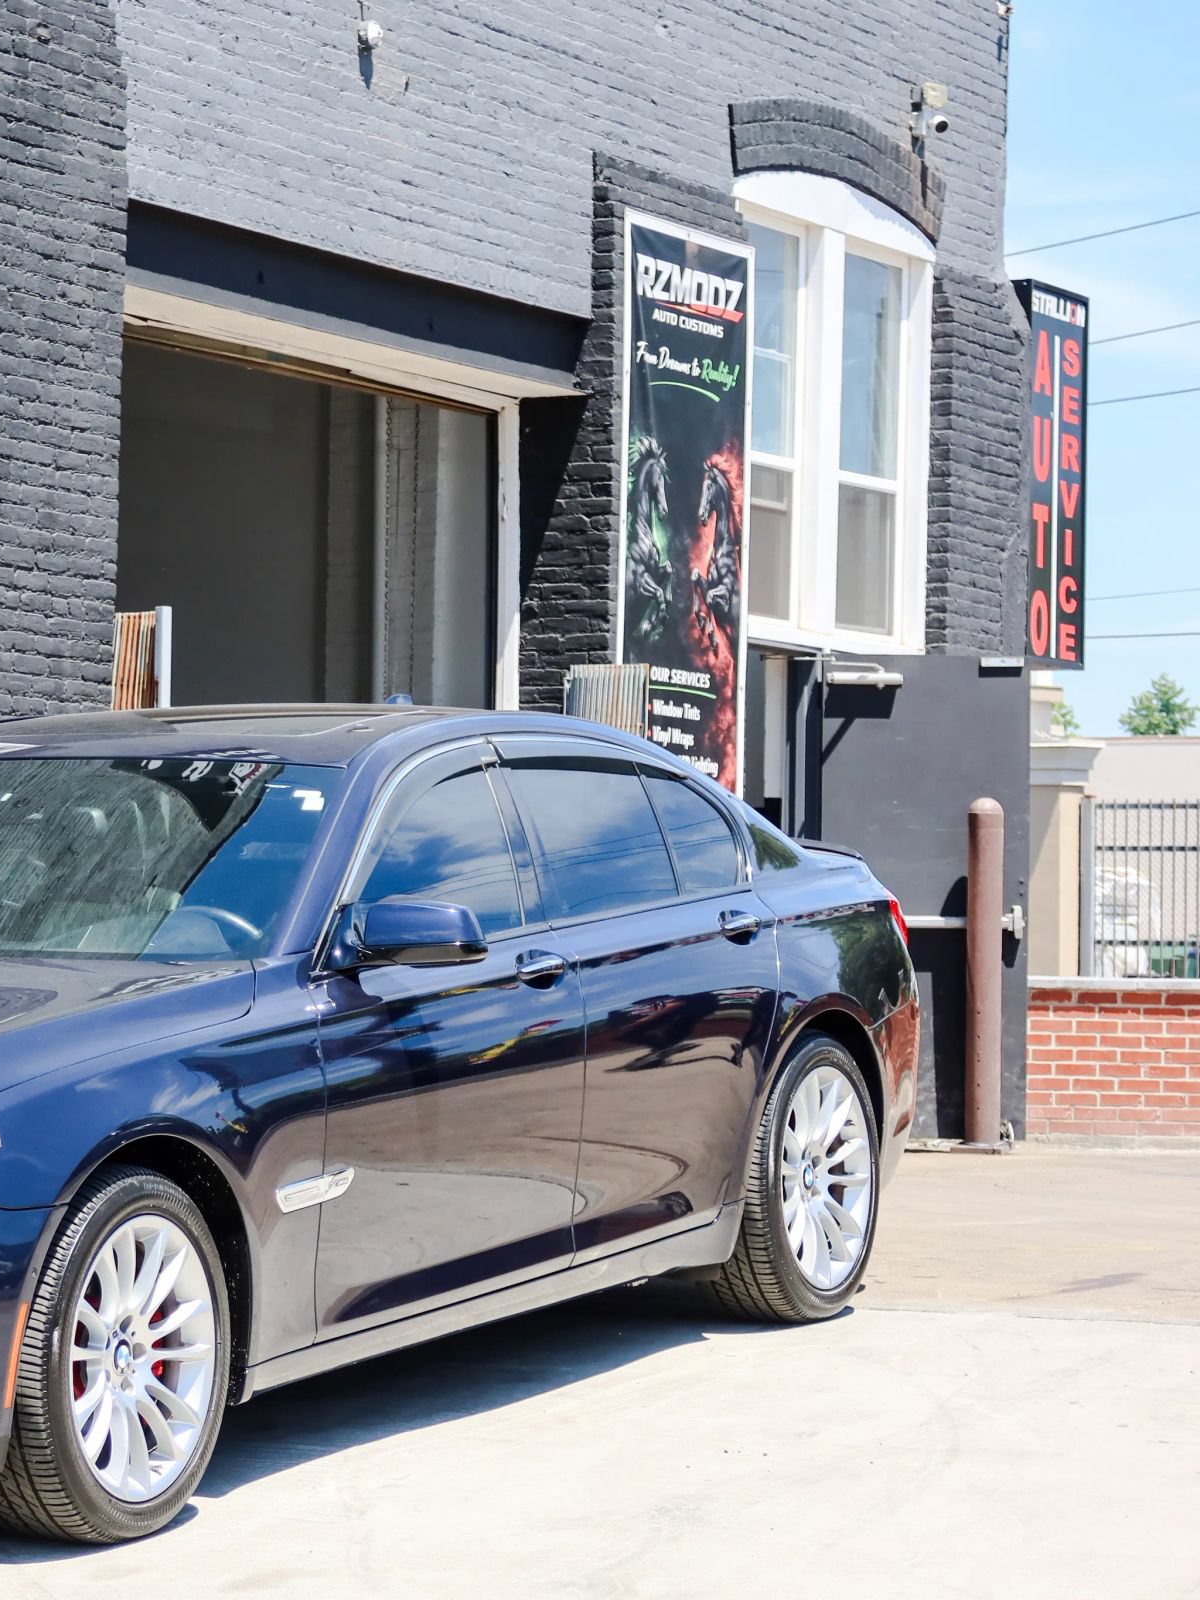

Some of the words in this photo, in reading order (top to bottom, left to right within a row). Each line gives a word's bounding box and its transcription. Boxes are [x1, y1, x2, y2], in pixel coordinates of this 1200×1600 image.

[636, 253, 744, 323] RZMODZ
[1032, 288, 1086, 328] STALLION
[652, 308, 678, 326] AUTO
[678, 316, 725, 338] CUSTOMS
[636, 341, 658, 364] From
[658, 346, 691, 375] Dreams
[691, 357, 701, 377] to
[701, 358, 740, 391] Reality!
[1029, 329, 1052, 657] AUTO
[1059, 339, 1081, 662] SERVICE
[650, 666, 670, 683] OUR
[670, 669, 710, 688] SERVICES
[652, 699, 683, 718] Window
[683, 702, 701, 721] Tints
[652, 725, 671, 747] Vinyl
[672, 729, 694, 750] Wraps
